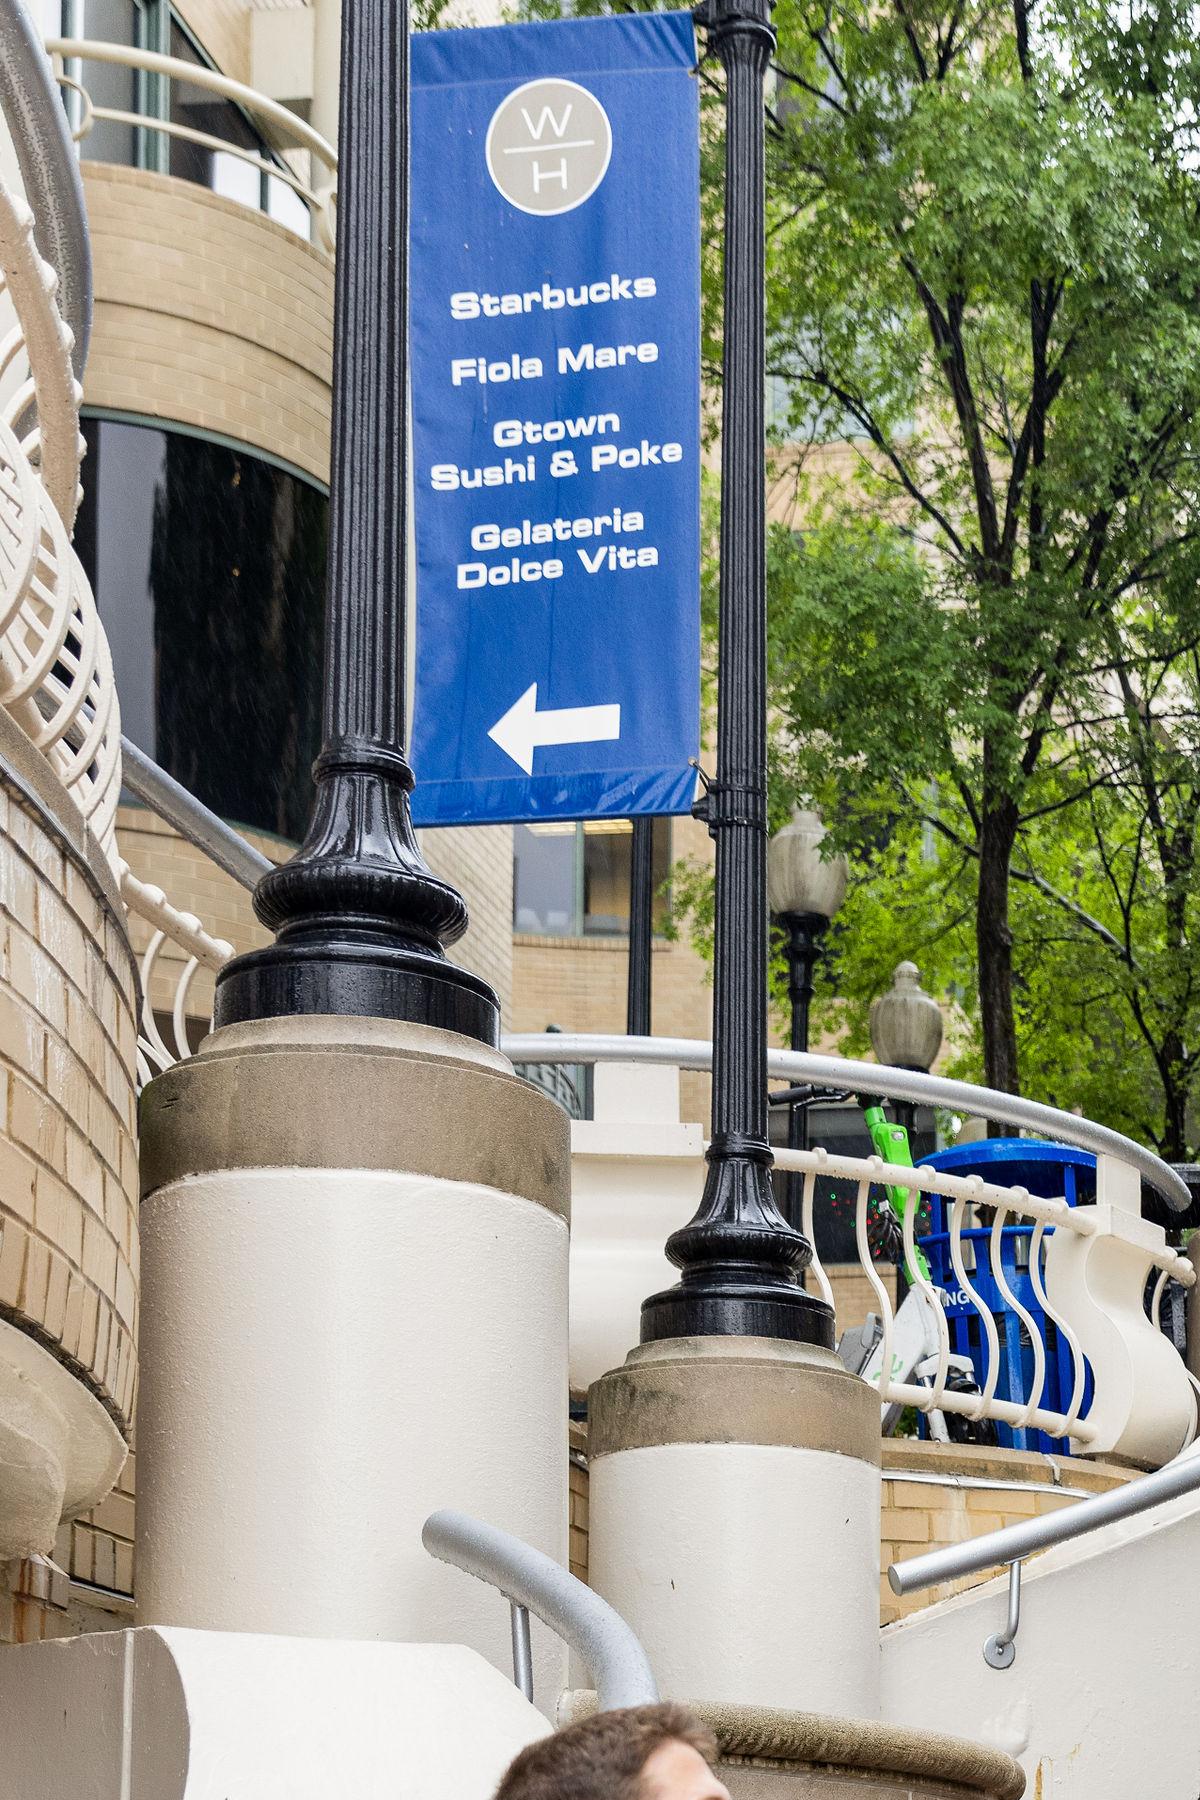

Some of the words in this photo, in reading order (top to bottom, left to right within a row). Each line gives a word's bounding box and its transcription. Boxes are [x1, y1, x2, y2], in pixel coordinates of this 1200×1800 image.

[521, 104, 573, 141] W
[532, 158, 568, 194] H
[450, 273, 657, 320] Starbucks
[451, 353, 543, 386] Fiola
[557, 342, 659, 374] Mare
[493, 412, 620, 448] Gtown
[430, 455, 536, 491] Sushi
[549, 450, 579, 478] &
[591, 439, 683, 472] Poke
[470, 507, 644, 551] Gelateria
[456, 557, 564, 590] Dolce
[576, 545, 659, 574] Vita
